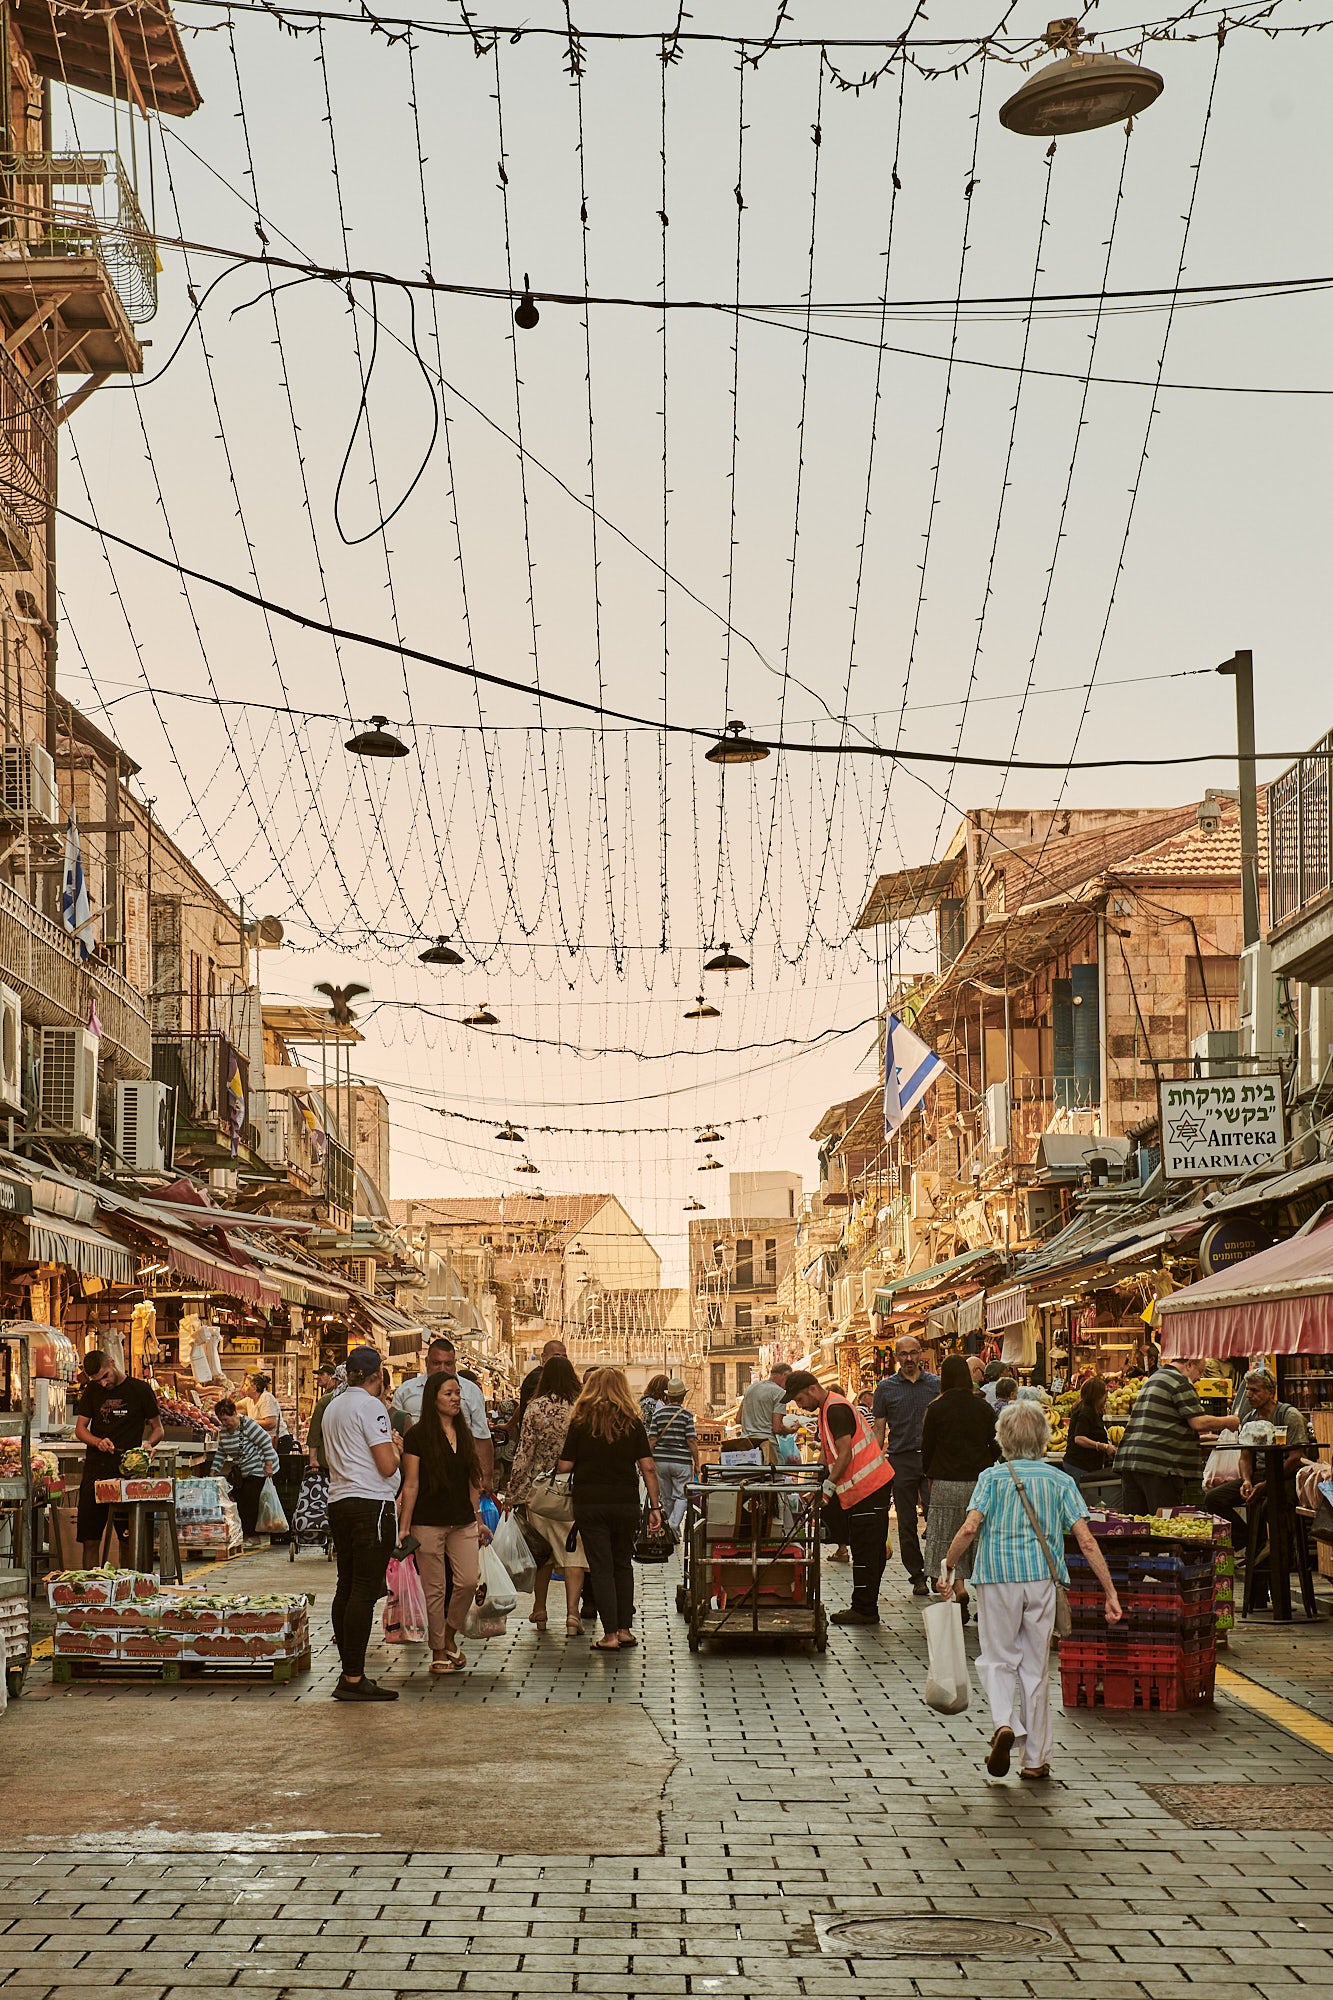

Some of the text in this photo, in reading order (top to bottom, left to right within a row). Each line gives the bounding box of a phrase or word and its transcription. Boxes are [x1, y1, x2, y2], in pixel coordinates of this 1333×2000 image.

[1168, 1084, 1276, 1110] בית מרקחת
[1207, 1129, 1277, 1147] Аптека
[1224, 1240, 1256, 1250] כספומט
